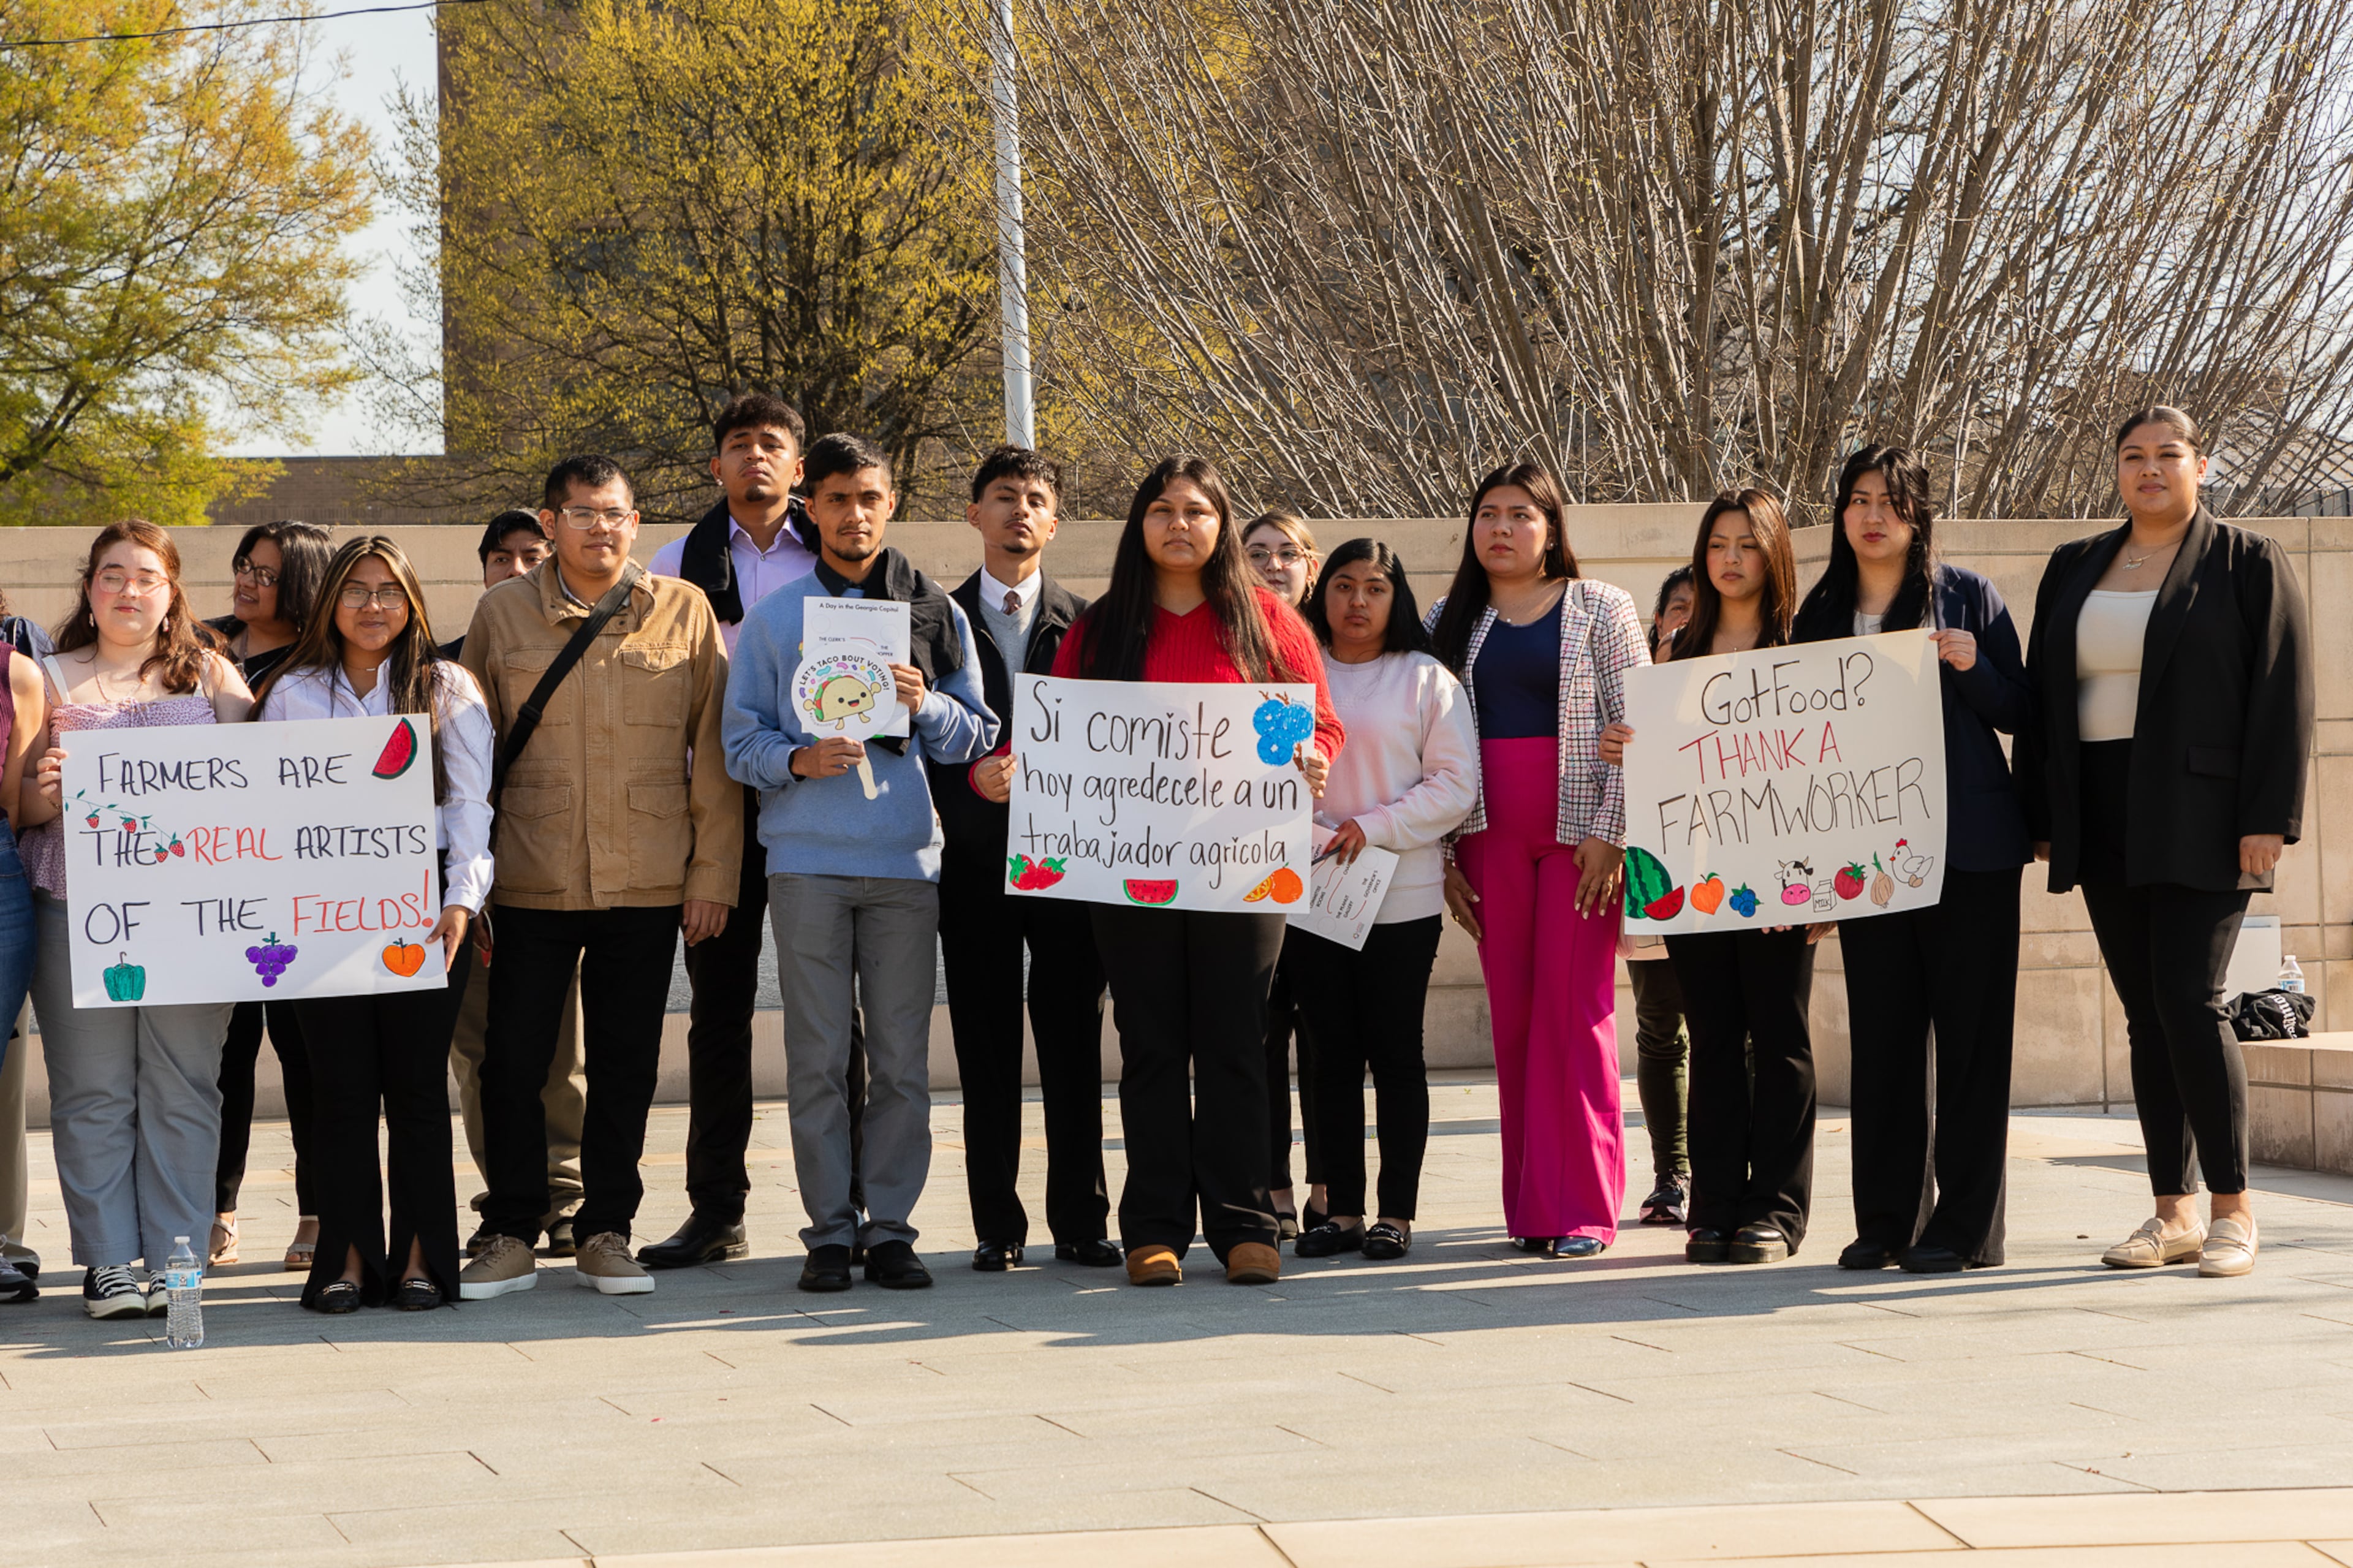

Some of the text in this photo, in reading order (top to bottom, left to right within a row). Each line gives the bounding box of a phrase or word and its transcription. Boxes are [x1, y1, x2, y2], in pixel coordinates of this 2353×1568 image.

[799, 665, 817, 685] LET'S
[817, 656, 839, 667] TACO
[842, 655, 865, 664] BOUT
[867, 661, 890, 691] VOTING!
[1031, 680, 1232, 760] Si comiste
[98, 752, 352, 796] FARMERS ARE
[1678, 721, 1841, 784] THANK A
[1022, 752, 1297, 826] hoy agredecele a un
[1658, 757, 1930, 854] FARMWORKER
[79, 825, 427, 867] THE REAL ARTISTS
[1020, 812, 1286, 890] trabajador agricola
[1339, 895, 1349, 911] PEANUT
[1363, 870, 1378, 898] GOVERNOR'S
[1373, 879, 1381, 893] OFFICE
[85, 869, 434, 945] OF THE FIELDS!
[1343, 900, 1353, 918] GALLERY
